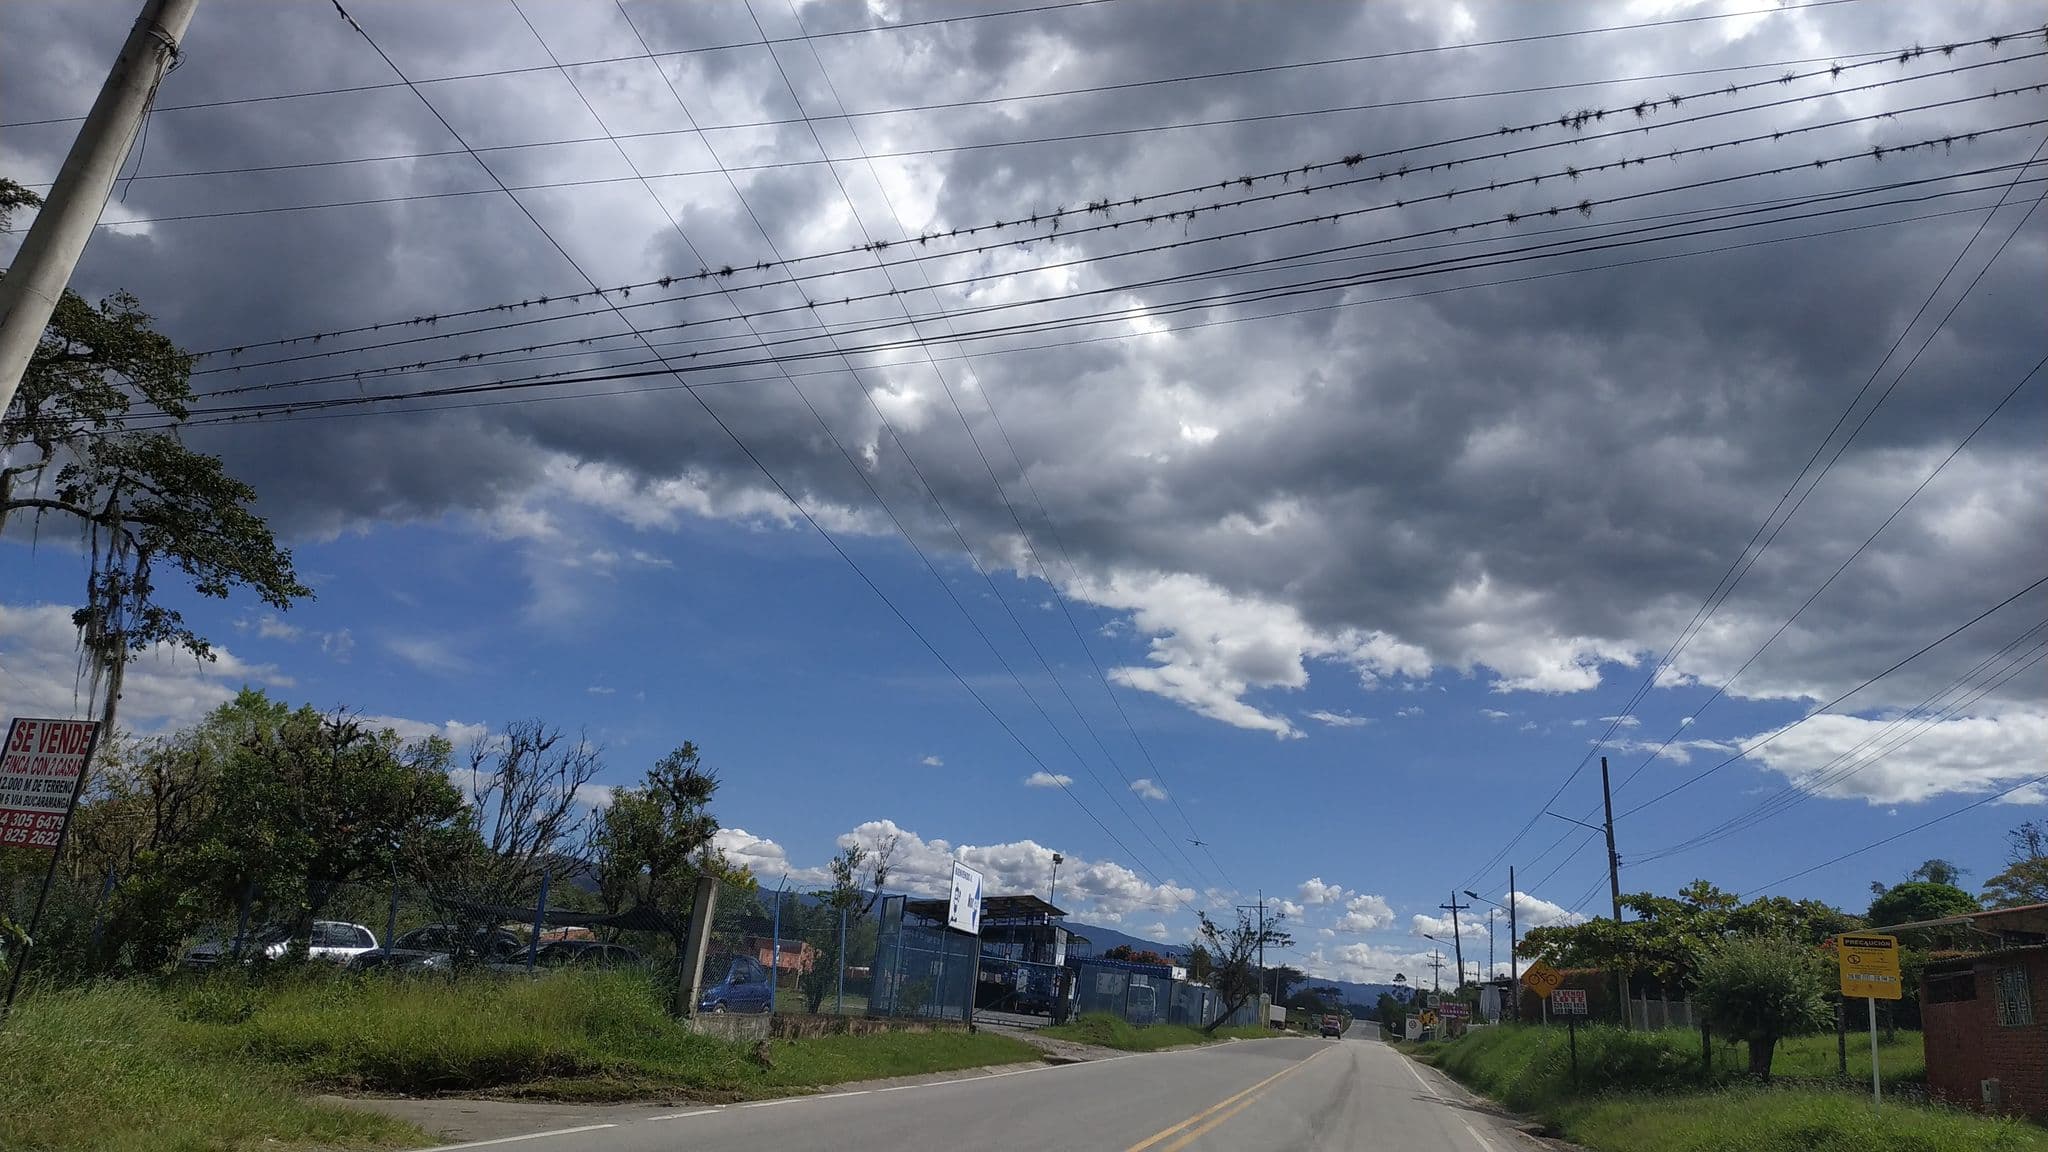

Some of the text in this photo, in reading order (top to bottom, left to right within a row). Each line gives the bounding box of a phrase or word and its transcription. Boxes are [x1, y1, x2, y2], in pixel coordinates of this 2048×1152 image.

[11, 721, 94, 755] SE VENDE
[1, 755, 83, 778] FINCA CON 2 CASAS
[23, 778, 32, 792] M
[31, 779, 43, 793] DE
[42, 780, 74, 795] TERRENO
[10, 812, 36, 829] 305
[36, 815, 66, 831] 6479
[4, 828, 28, 843] 825
[29, 830, 61, 846] 2622
